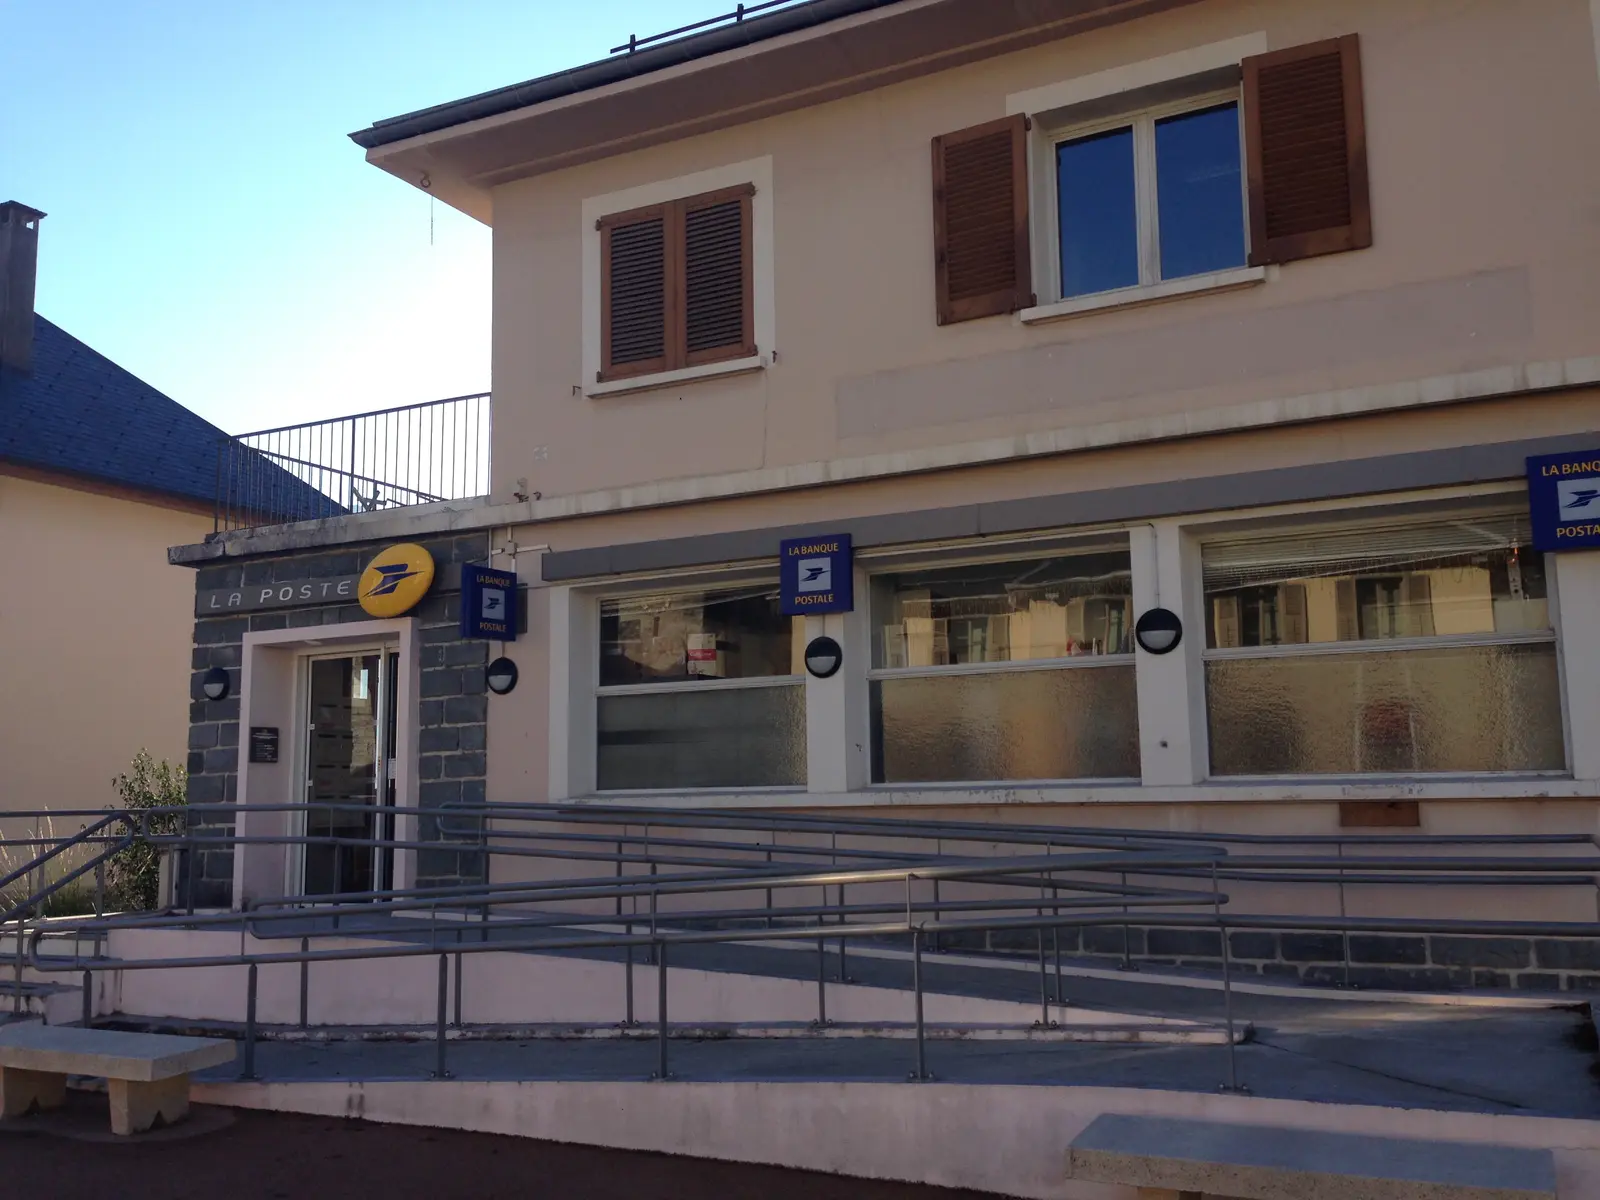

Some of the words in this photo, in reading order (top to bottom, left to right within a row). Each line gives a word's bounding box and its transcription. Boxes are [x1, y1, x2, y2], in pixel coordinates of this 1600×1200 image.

[1542, 465, 1559, 476] LA
[788, 547, 800, 556] LA
[801, 543, 839, 555] BANQUE
[476, 574, 485, 584] LA
[485, 575, 511, 588] BANQUE
[210, 592, 242, 608] LA
[259, 580, 351, 604] POSTE
[794, 594, 834, 606] POSTALE
[480, 622, 507, 633] POSTALE
